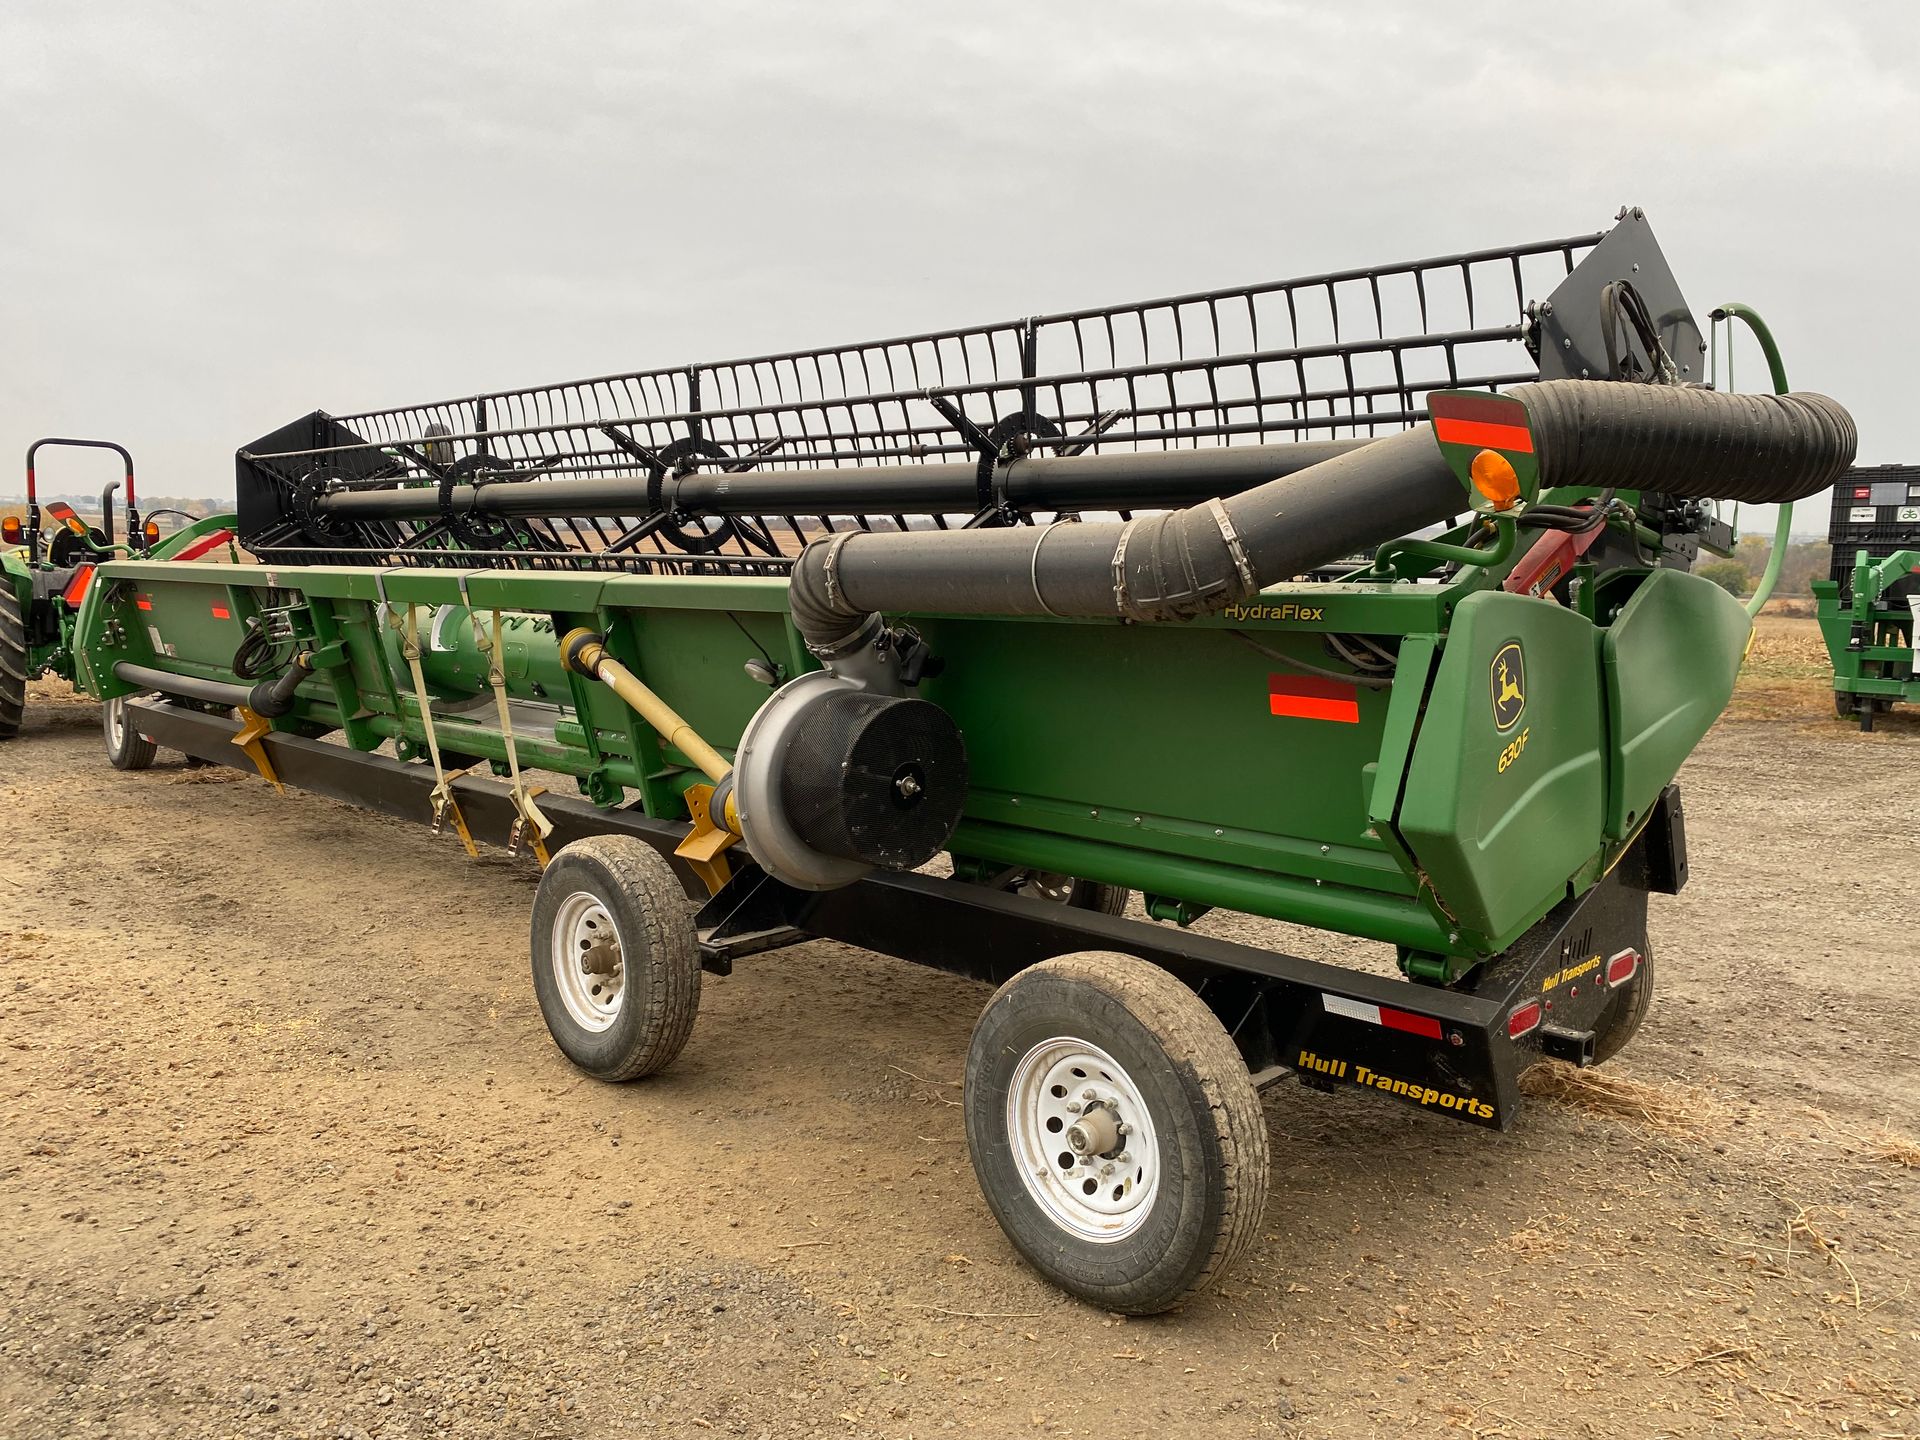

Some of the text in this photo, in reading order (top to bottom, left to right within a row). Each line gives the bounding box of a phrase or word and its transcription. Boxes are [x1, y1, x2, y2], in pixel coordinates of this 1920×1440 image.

[1224, 603, 1323, 621] HydraFlex
[1498, 726, 1530, 774] 630F
[1542, 955, 1601, 992] Hull Transports
[1298, 1050, 1495, 1119] Hull Transports
